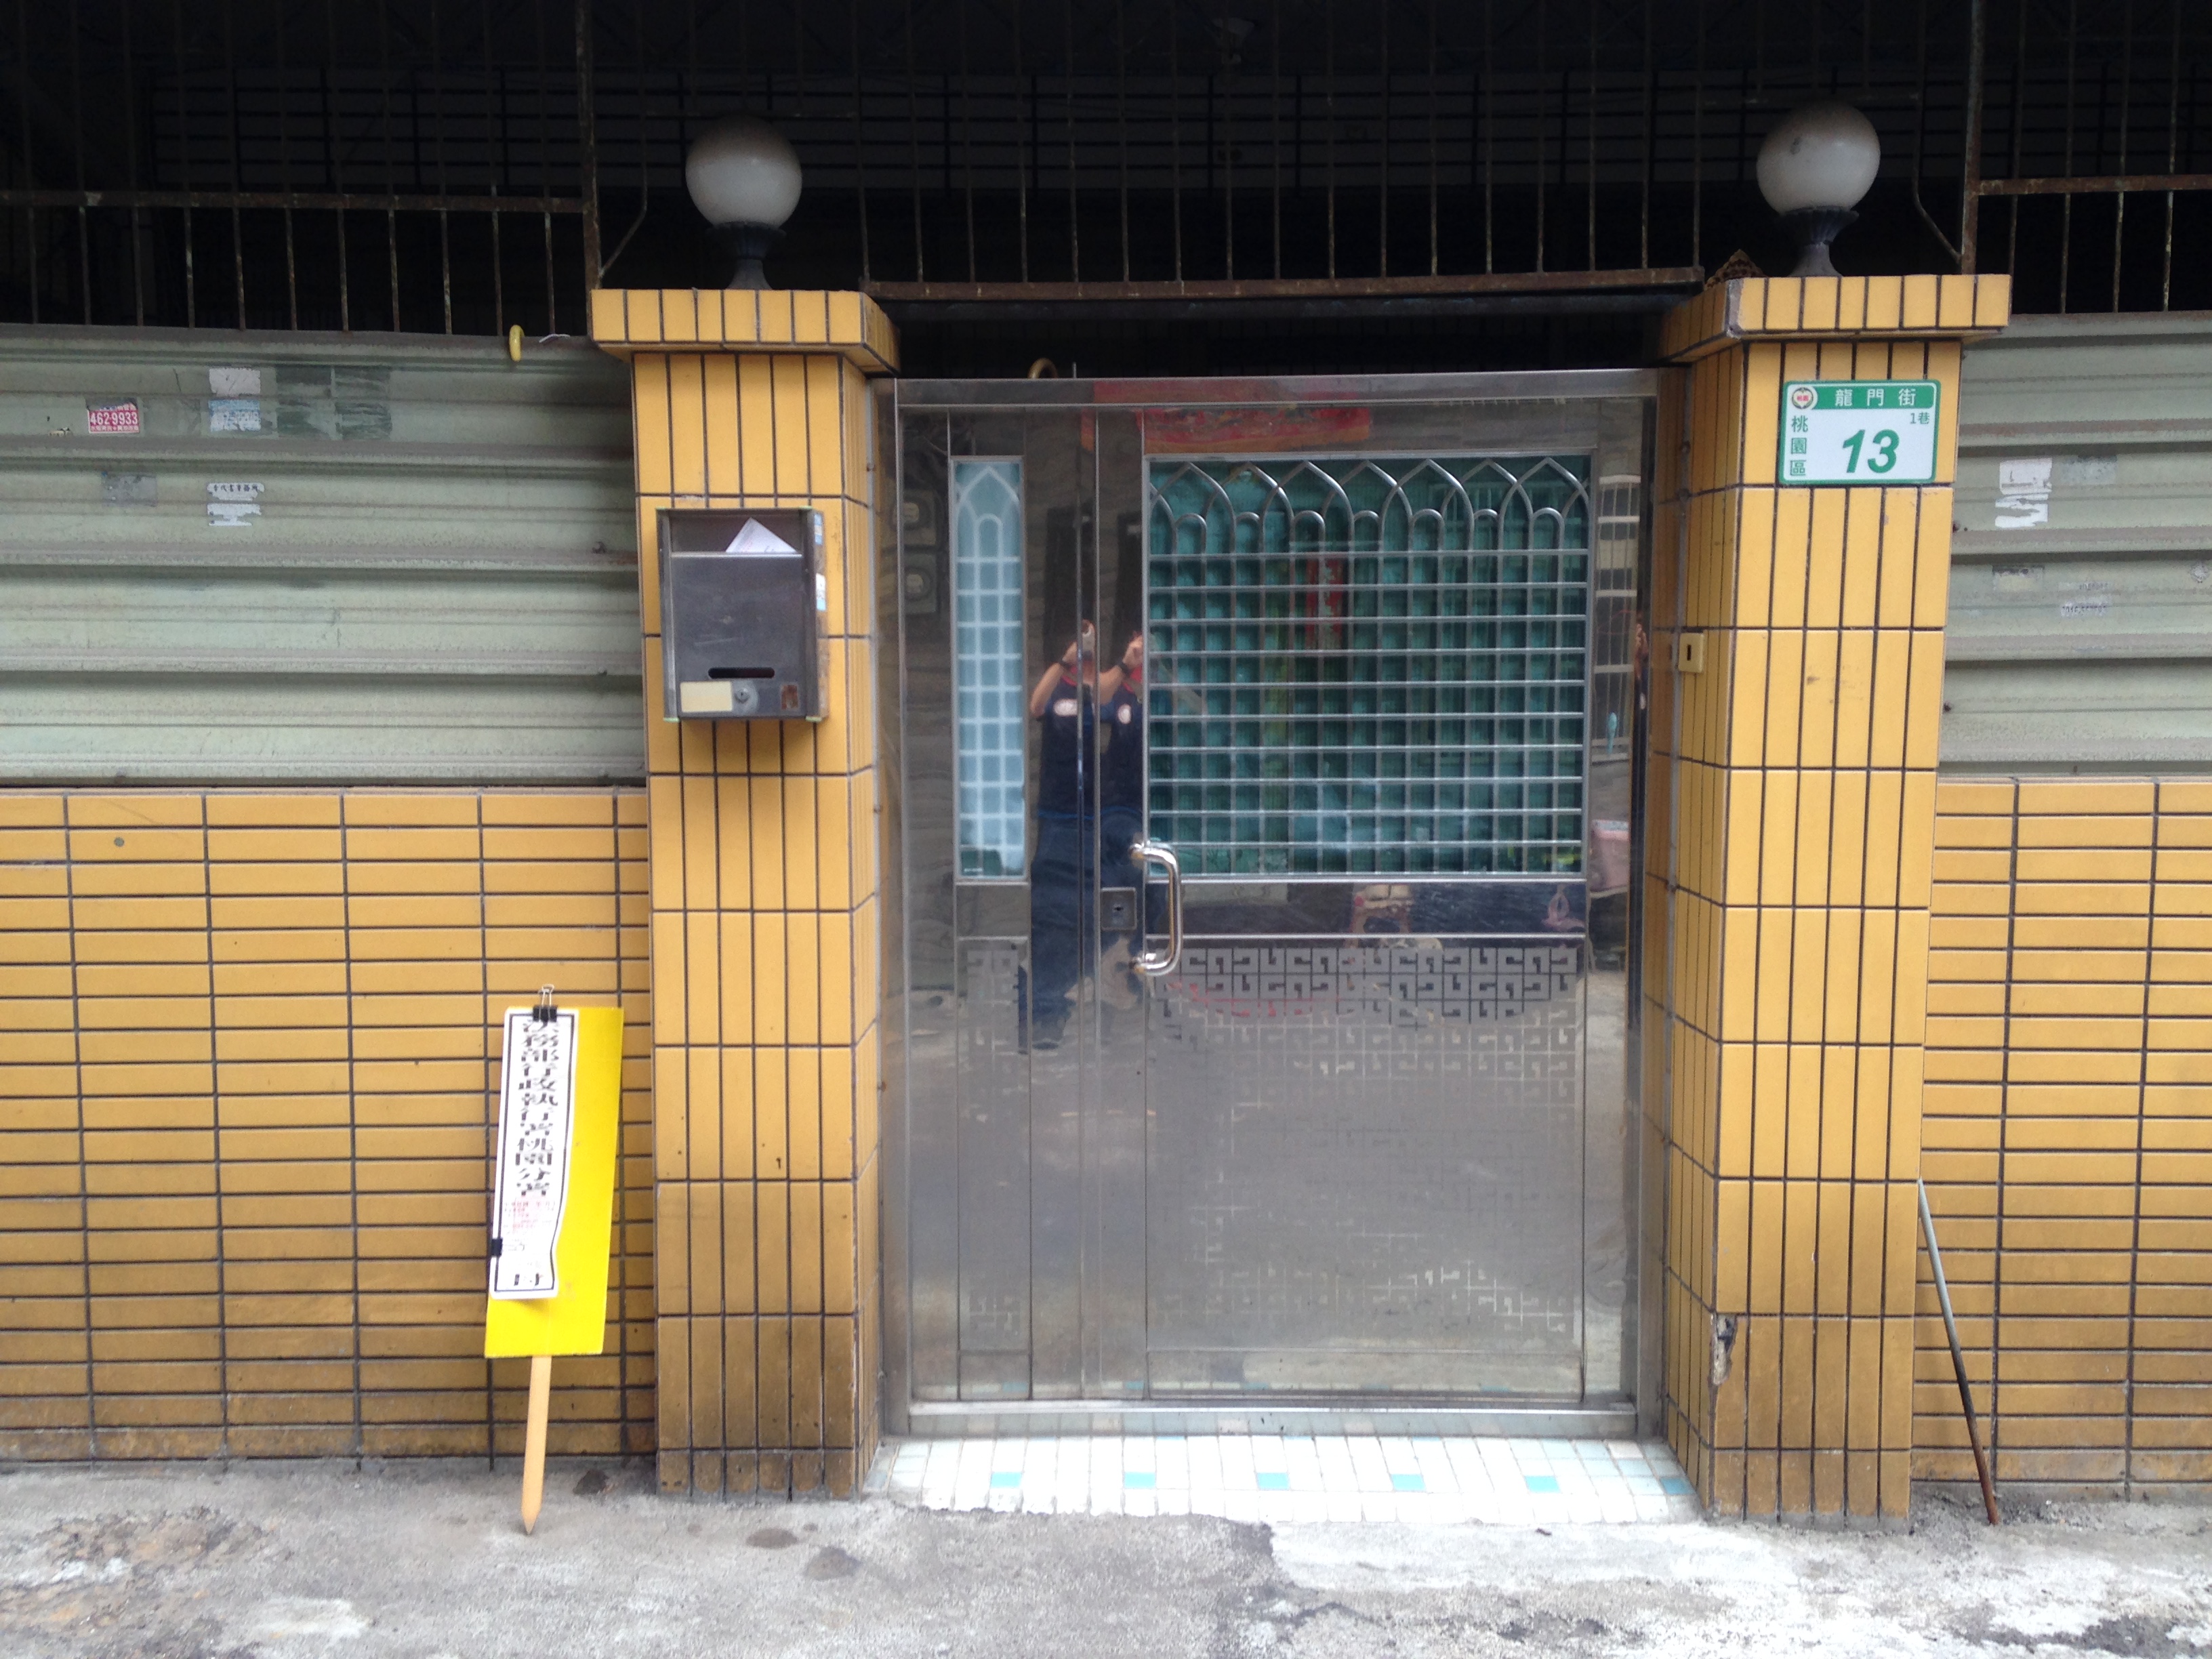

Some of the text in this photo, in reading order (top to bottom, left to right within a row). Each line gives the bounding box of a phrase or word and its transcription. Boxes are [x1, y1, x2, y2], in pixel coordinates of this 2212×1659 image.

[1834, 388, 1917, 407] 龍門街
[1909, 411, 1930, 424] 1巷
[1790, 415, 1809, 476] 桃園區
[1842, 429, 1900, 473] 13
